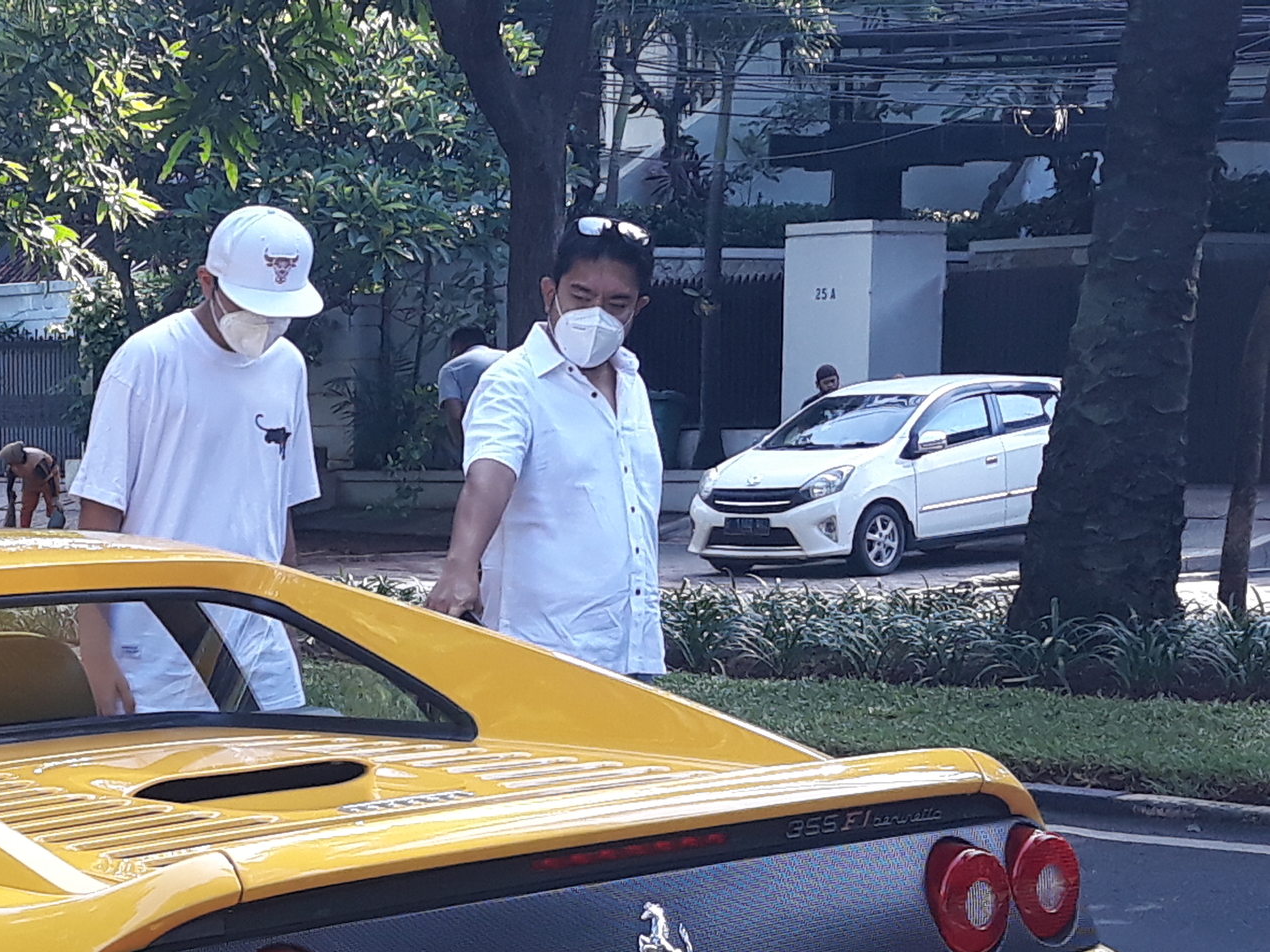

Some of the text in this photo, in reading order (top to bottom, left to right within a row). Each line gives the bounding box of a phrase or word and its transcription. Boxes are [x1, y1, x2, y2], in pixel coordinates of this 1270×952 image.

[815, 287, 836, 300] 25 A
[785, 814, 839, 838] 355
